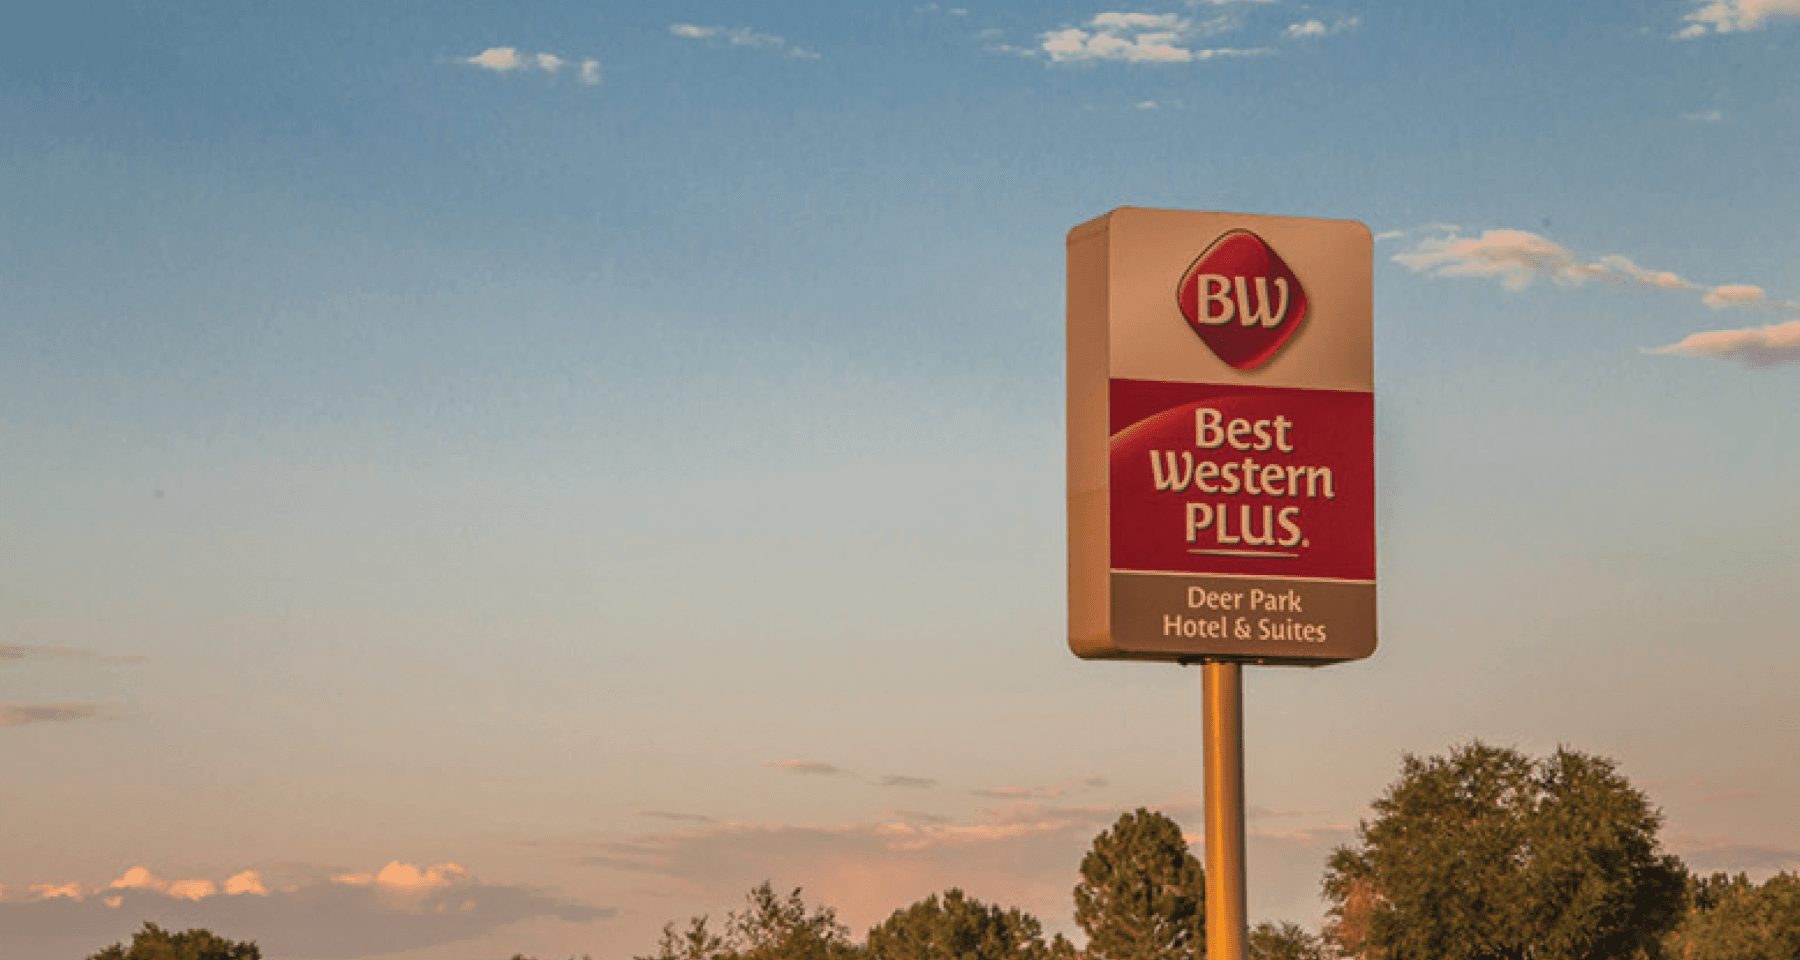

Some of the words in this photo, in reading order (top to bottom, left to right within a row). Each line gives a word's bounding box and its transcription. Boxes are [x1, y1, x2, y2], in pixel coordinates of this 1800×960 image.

[1197, 274, 1289, 328] BW
[1195, 407, 1293, 453] Best
[1150, 449, 1335, 499] Western
[1187, 586, 1245, 611] Deer
[1250, 588, 1303, 613] Park
[1163, 614, 1229, 639] Hotel
[1234, 616, 1252, 640] &
[1257, 618, 1328, 643] Suites
